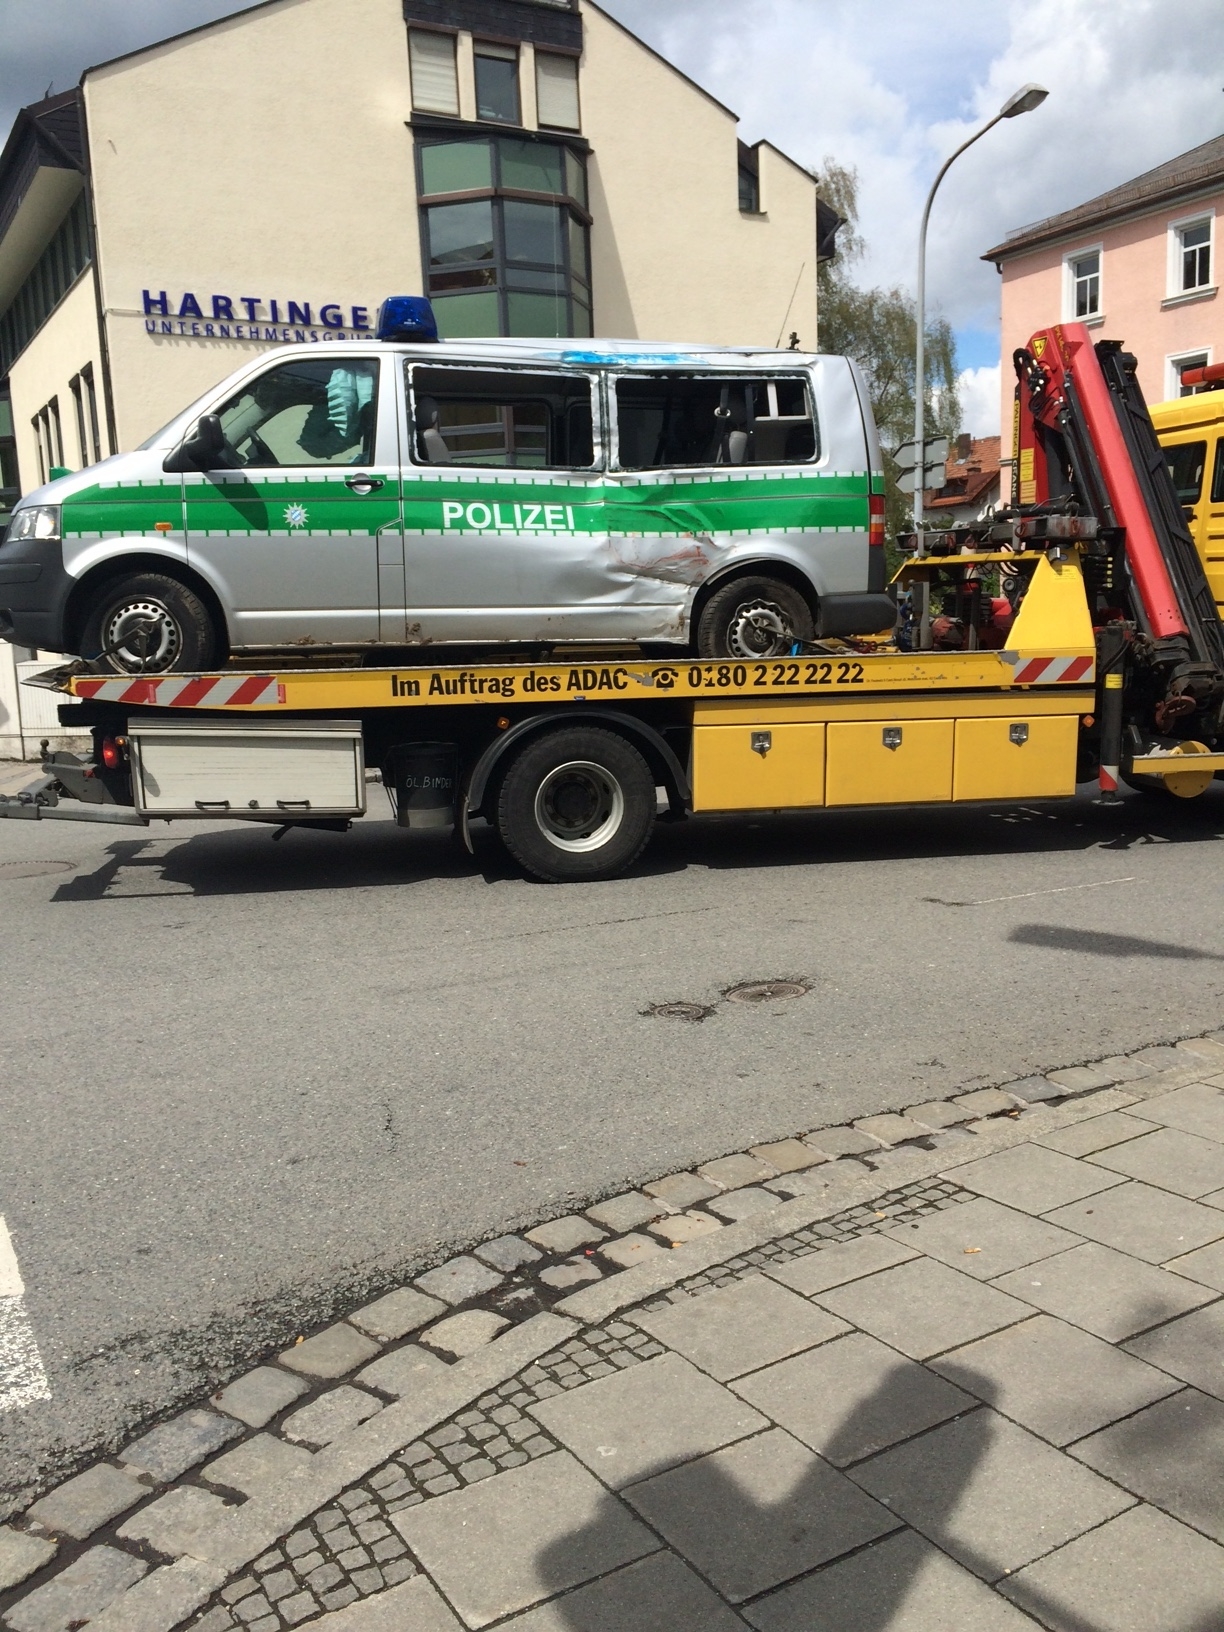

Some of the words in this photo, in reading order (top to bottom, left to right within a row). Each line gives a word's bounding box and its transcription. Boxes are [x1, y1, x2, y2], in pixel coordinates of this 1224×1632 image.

[142, 289, 379, 331] HARTINGE
[442, 501, 575, 530] POLIZEI
[391, 674, 420, 697] Im
[428, 672, 516, 697] Auftrag
[522, 670, 561, 693] des
[566, 667, 628, 692] ADAC
[688, 665, 747, 688] 0180
[753, 664, 768, 686] 2
[771, 663, 800, 686] 22
[804, 662, 832, 685] 22
[837, 662, 864, 684] 22
